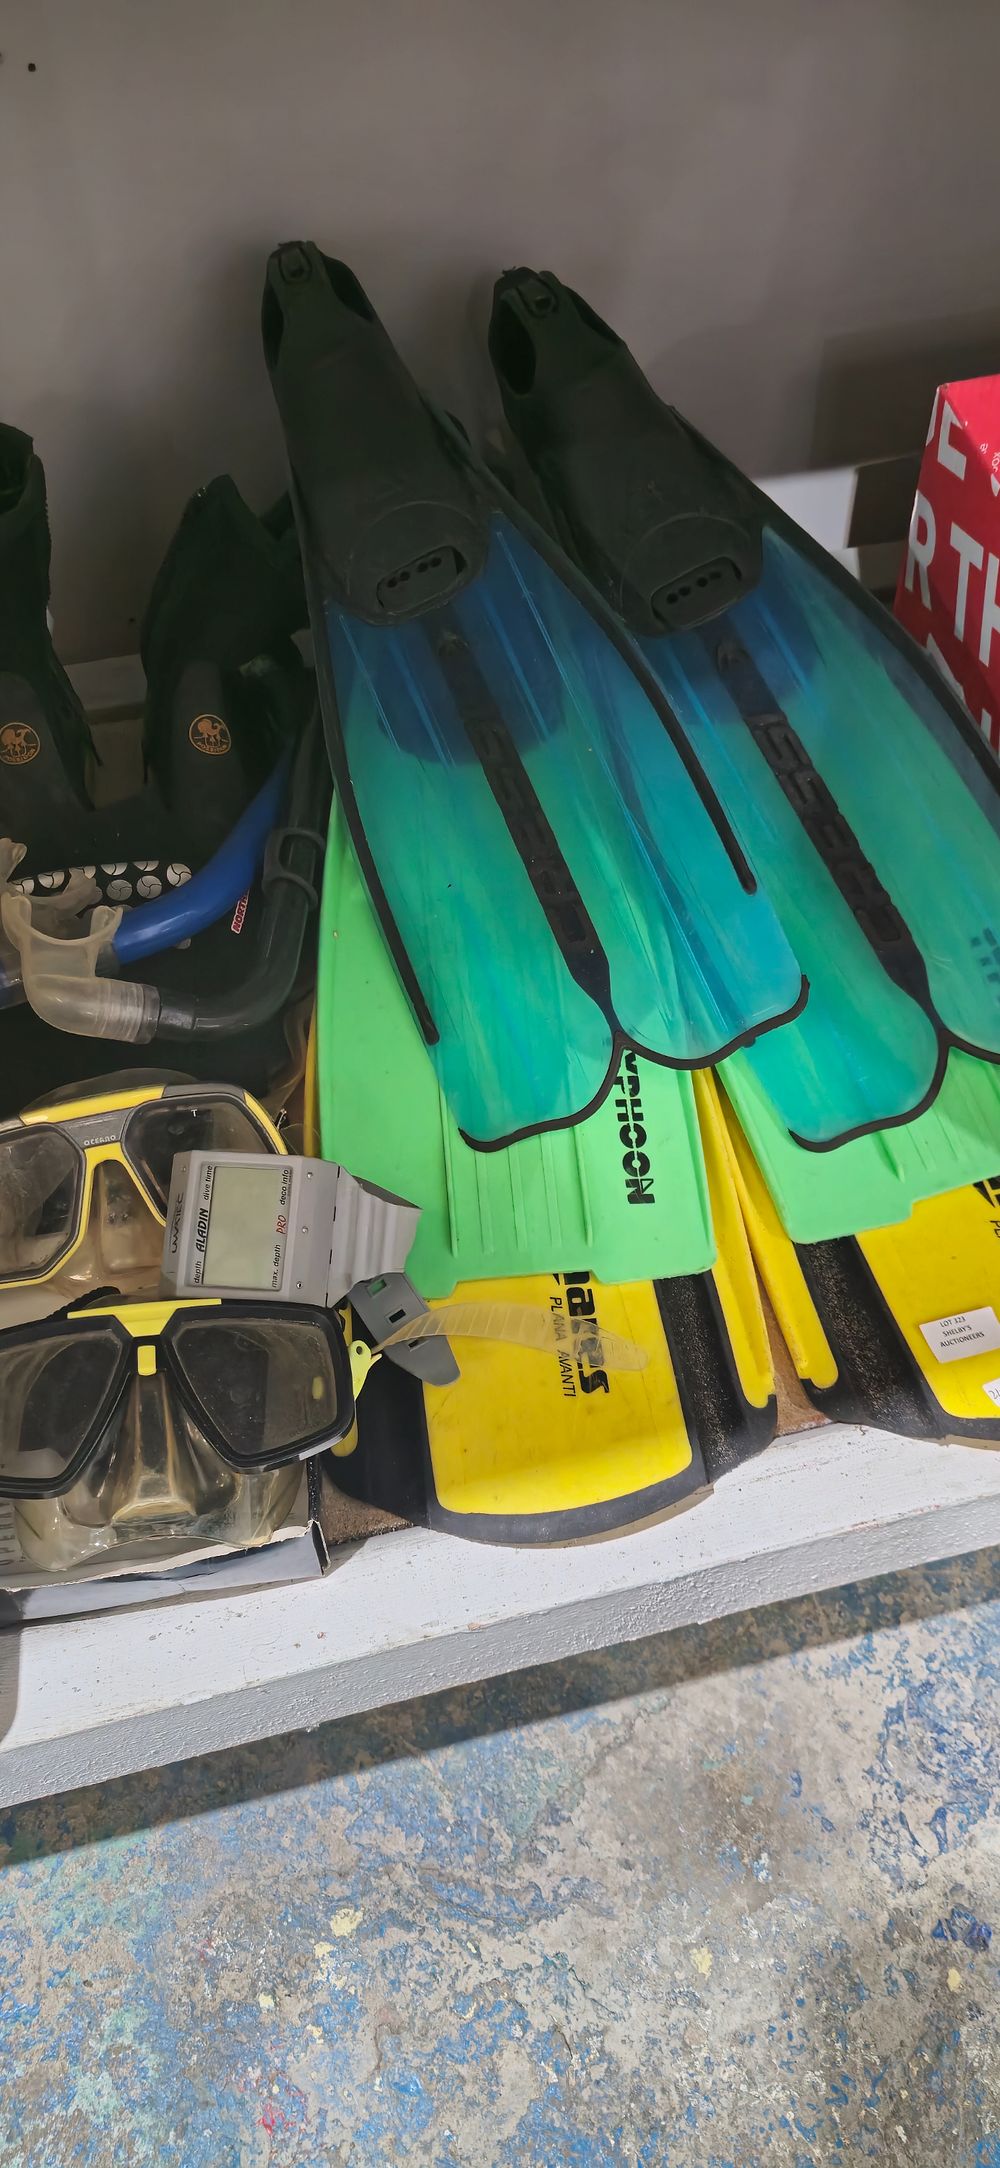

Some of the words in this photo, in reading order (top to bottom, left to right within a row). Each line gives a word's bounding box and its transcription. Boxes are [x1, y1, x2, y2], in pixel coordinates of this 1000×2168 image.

[282, 1169, 290, 1186] info
[203, 1183, 211, 1201] dive
[279, 1186, 288, 1206] deco
[195, 1208, 209, 1253] ALADIN
[275, 1214, 287, 1235] PRO
[273, 1244, 281, 1267] depth
[193, 1260, 202, 1284] depth
[549, 1295, 568, 1343] PLANA
[939, 1319, 953, 1328] LOT
[940, 1331, 985, 1348] AUCTIONEERS
[942, 1324, 972, 1337] SHELBY'S
[556, 1348, 577, 1398] AVANTI
